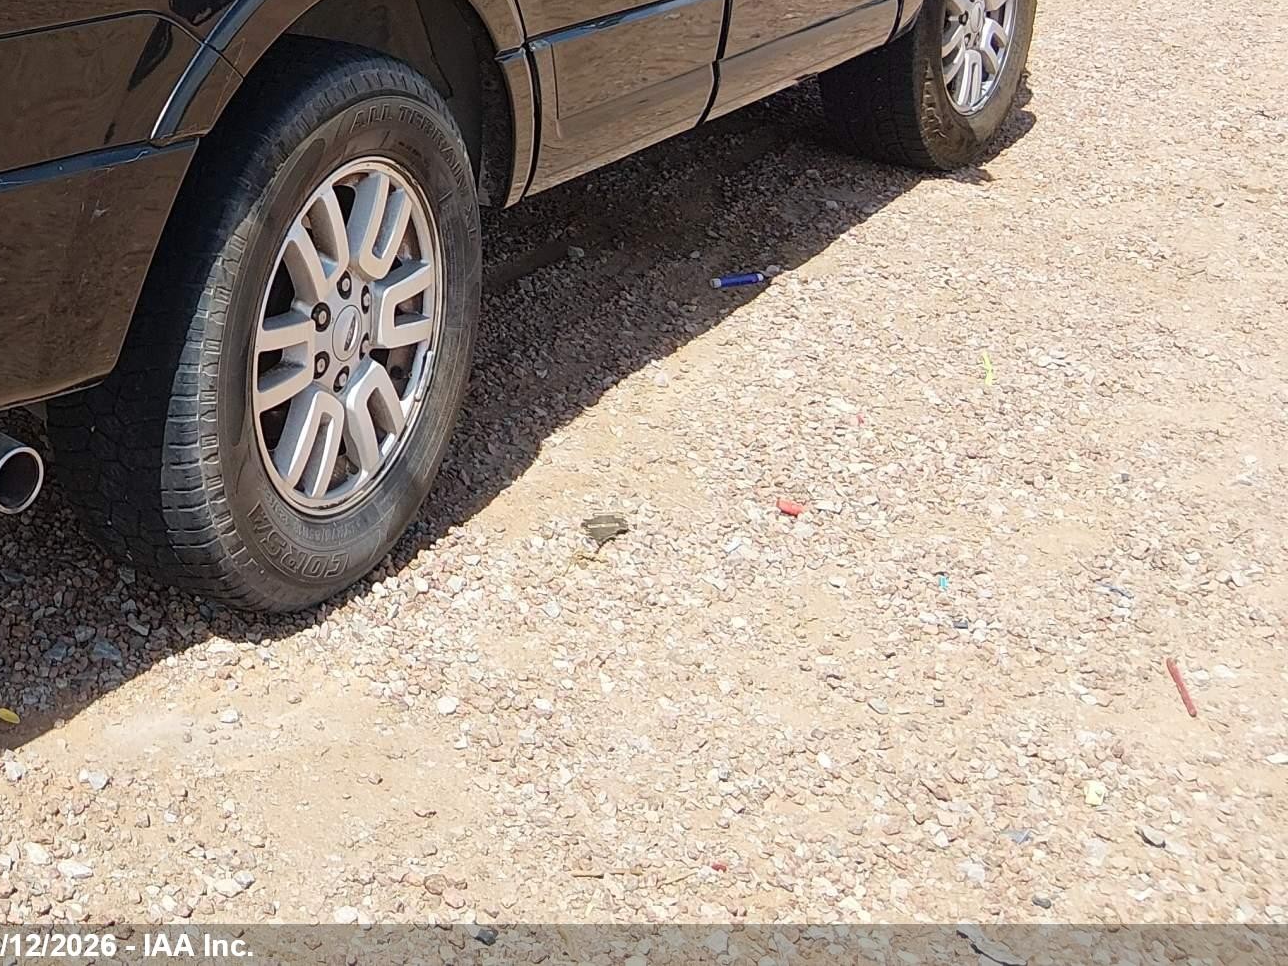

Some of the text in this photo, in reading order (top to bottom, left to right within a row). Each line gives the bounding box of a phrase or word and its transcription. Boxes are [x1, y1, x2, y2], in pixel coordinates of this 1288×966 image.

[349, 103, 394, 135] ALL
[398, 104, 470, 196] TERRAIN
[247, 500, 350, 579] CORSA
